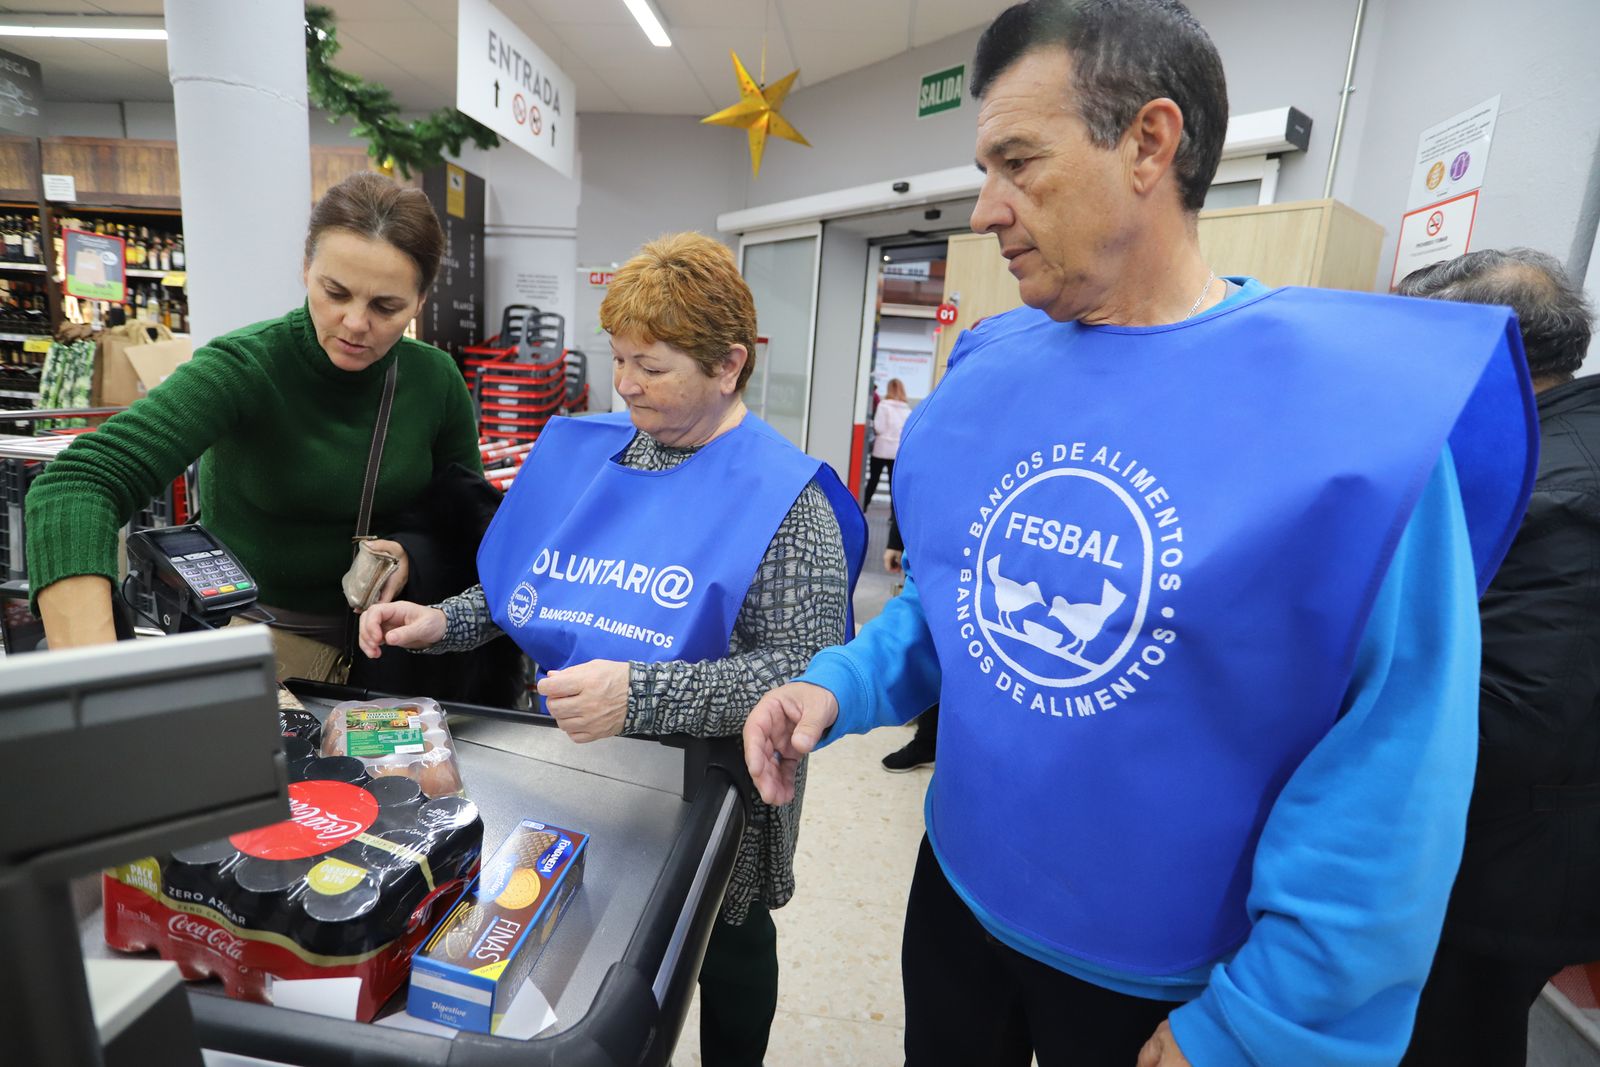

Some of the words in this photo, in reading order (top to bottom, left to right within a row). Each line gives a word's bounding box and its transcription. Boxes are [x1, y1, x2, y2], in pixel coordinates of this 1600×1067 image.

[488, 28, 561, 117] ENTRADA
[920, 74, 962, 109] SALIDA
[940, 309, 954, 321] 01
[968, 451, 1044, 539] BANCOS
[1052, 442, 1086, 463] DE
[1090, 446, 1184, 592] ALIMENTOS
[1005, 511, 1123, 569] FESBAL
[529, 547, 694, 609] OLUNTARI@
[539, 607, 577, 622] BANCOS
[576, 611, 595, 626] DE
[594, 616, 675, 649] ALIMENTOS
[956, 568, 994, 675] BANCOS
[995, 671, 1027, 704] DE
[1030, 627, 1177, 718] ALIMENTOS
[130, 864, 153, 881] PACK
[540, 838, 572, 873] FONTANEDA
[126, 874, 158, 894] AHORRO
[168, 886, 204, 901] ZERO
[208, 896, 247, 926] AZÚCAR
[167, 913, 248, 960] Coca-Cola
[475, 917, 521, 963] FINAS
[431, 1001, 467, 1017] Digestive
